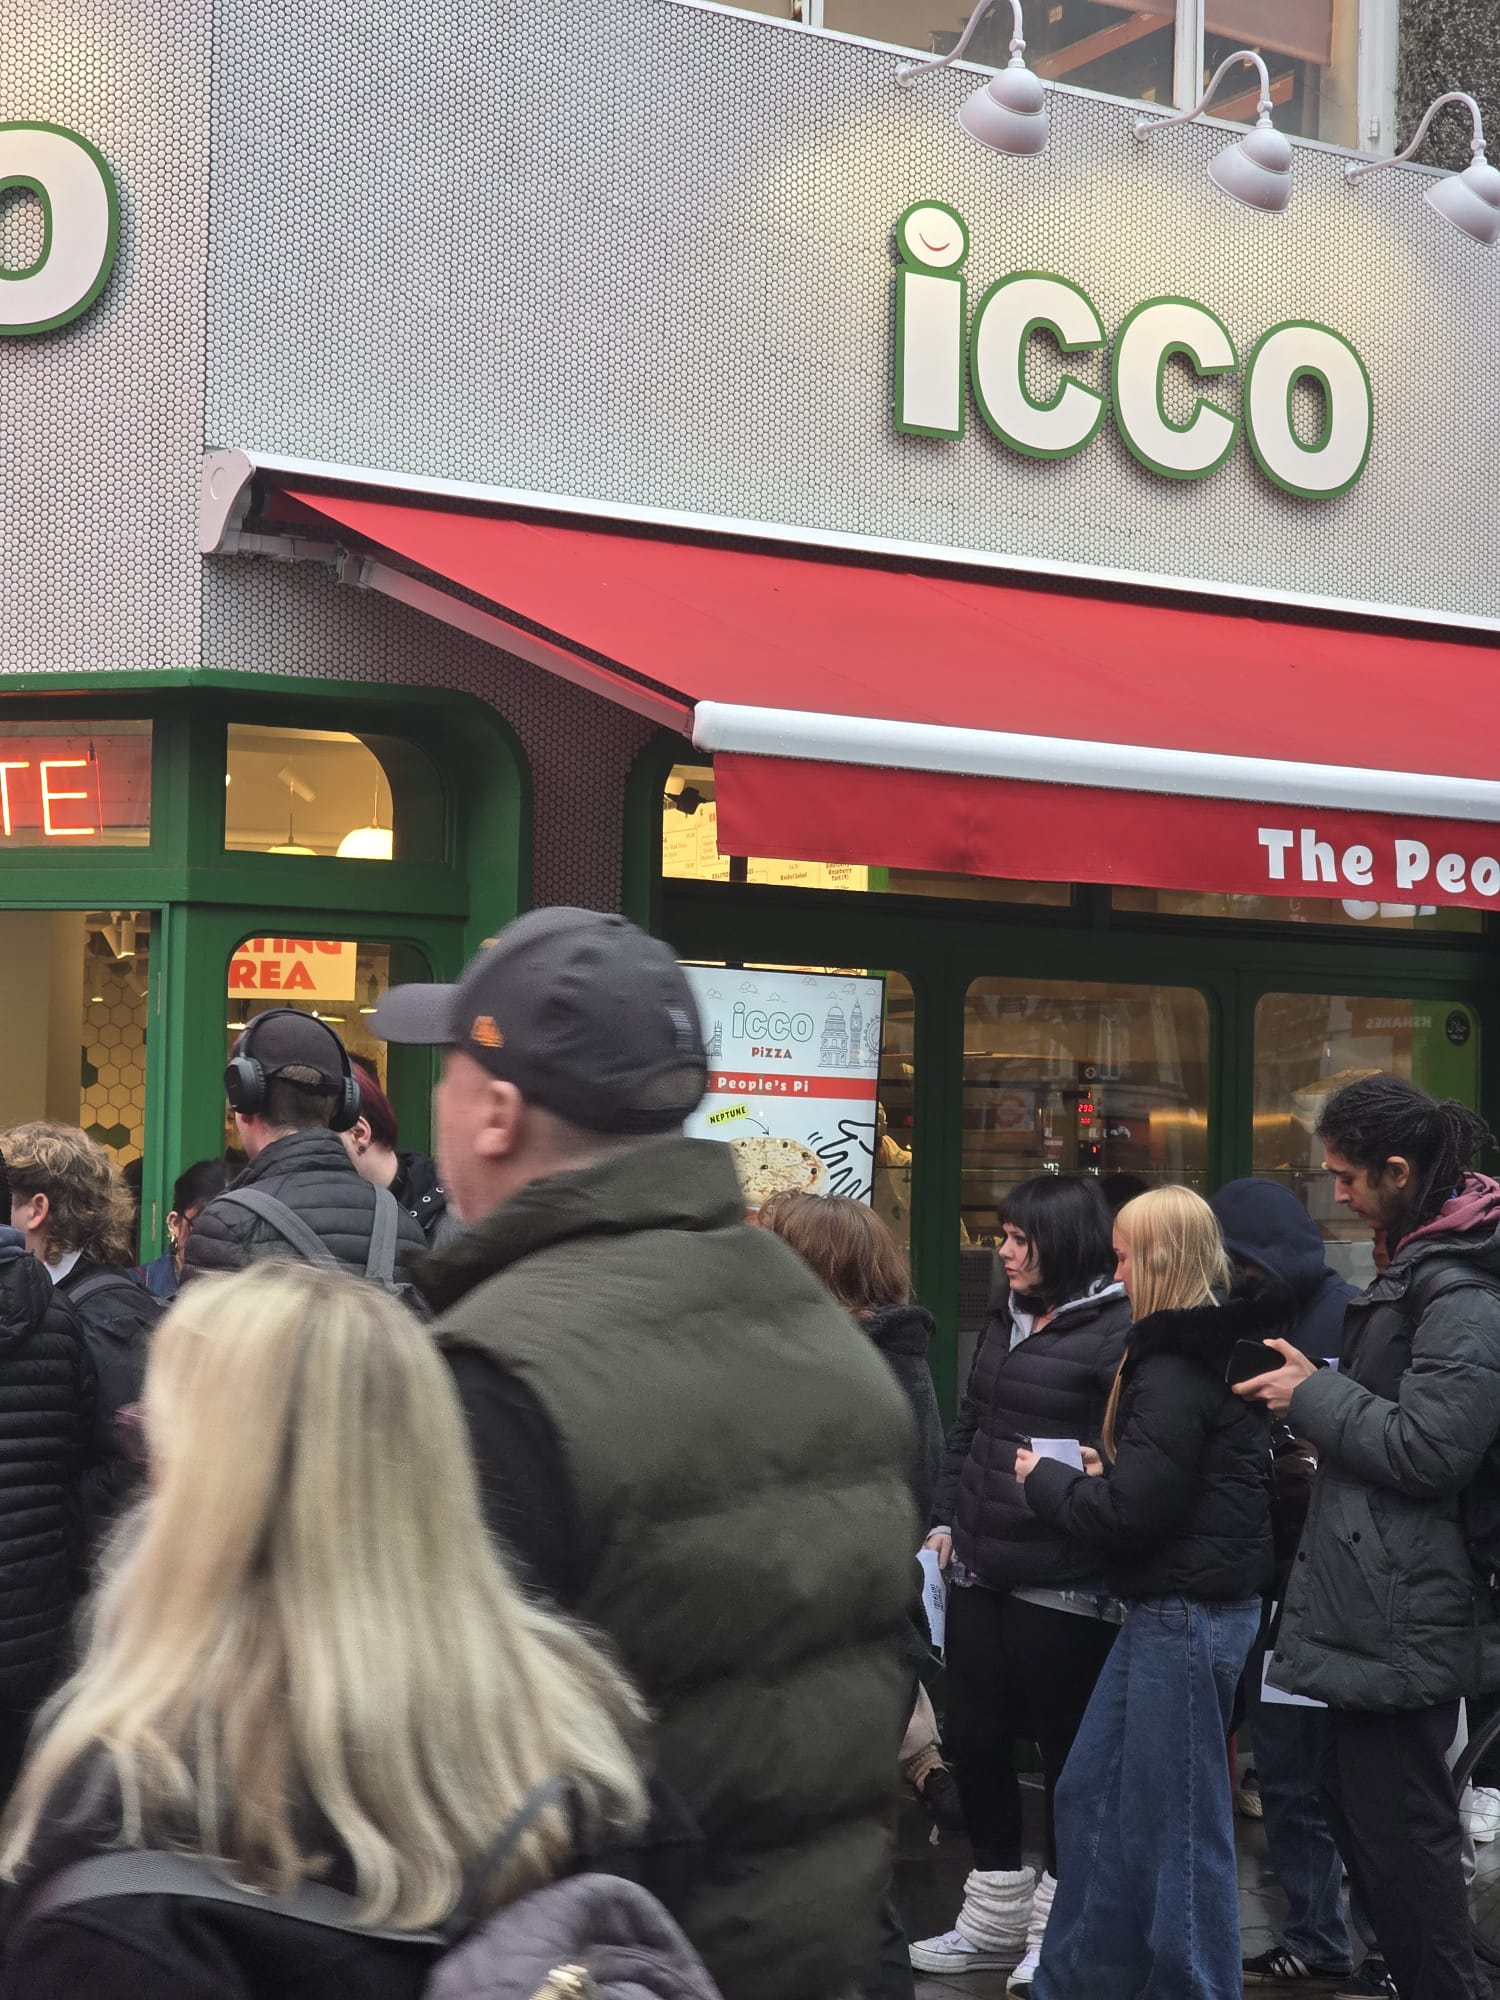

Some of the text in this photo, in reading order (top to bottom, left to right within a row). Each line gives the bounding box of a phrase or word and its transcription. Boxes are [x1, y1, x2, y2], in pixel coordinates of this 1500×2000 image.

[895, 199, 1374, 500] icco
[0, 759, 95, 836] TE
[1257, 827, 1500, 897] The Peo
[731, 1001, 815, 1043] icco
[793, 1078, 810, 1092] Pi
[710, 1106, 747, 1124] NEPTUNE
